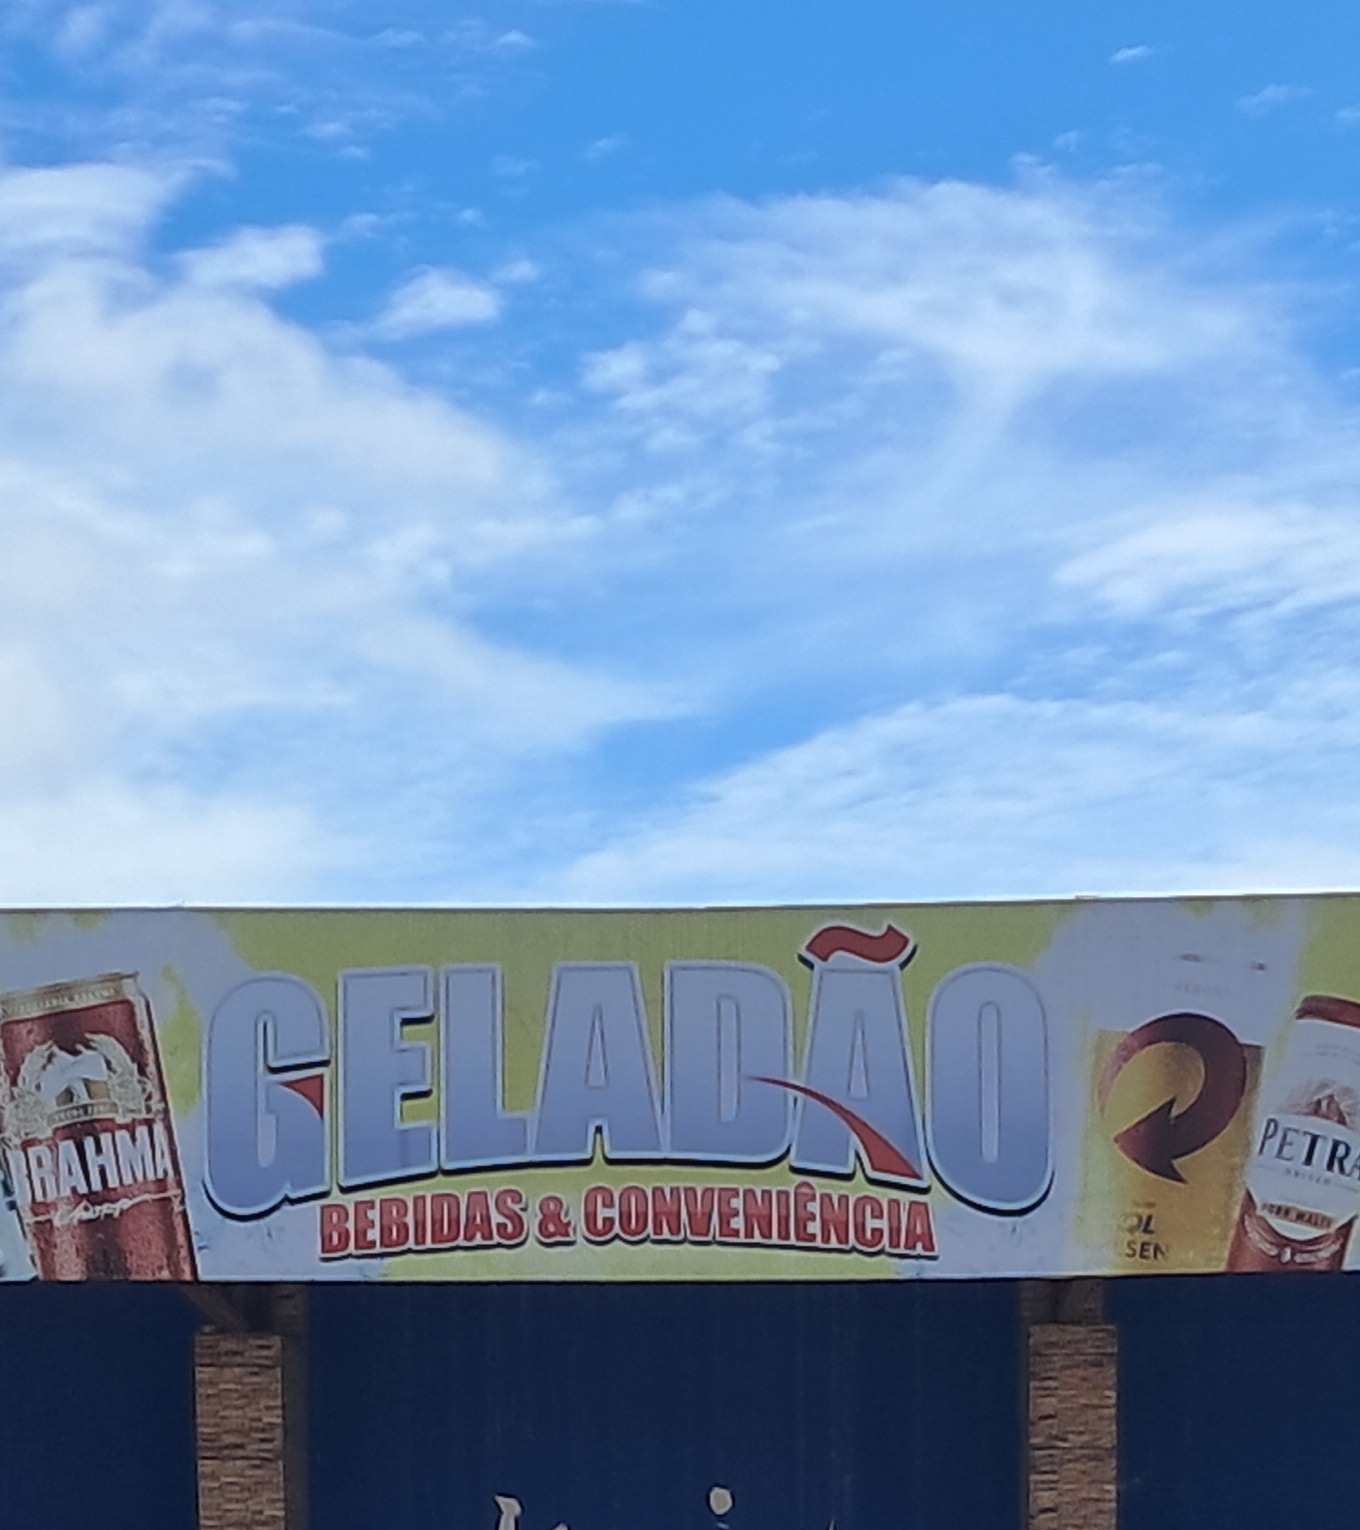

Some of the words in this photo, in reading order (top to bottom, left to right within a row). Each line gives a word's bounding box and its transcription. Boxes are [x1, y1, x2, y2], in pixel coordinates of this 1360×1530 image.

[203, 922, 1055, 1220] GELADÃO
[319, 1188, 526, 1259] BEBIDAS
[536, 1195, 575, 1239] &
[584, 1182, 938, 1257] CONVENIÊNCIA
